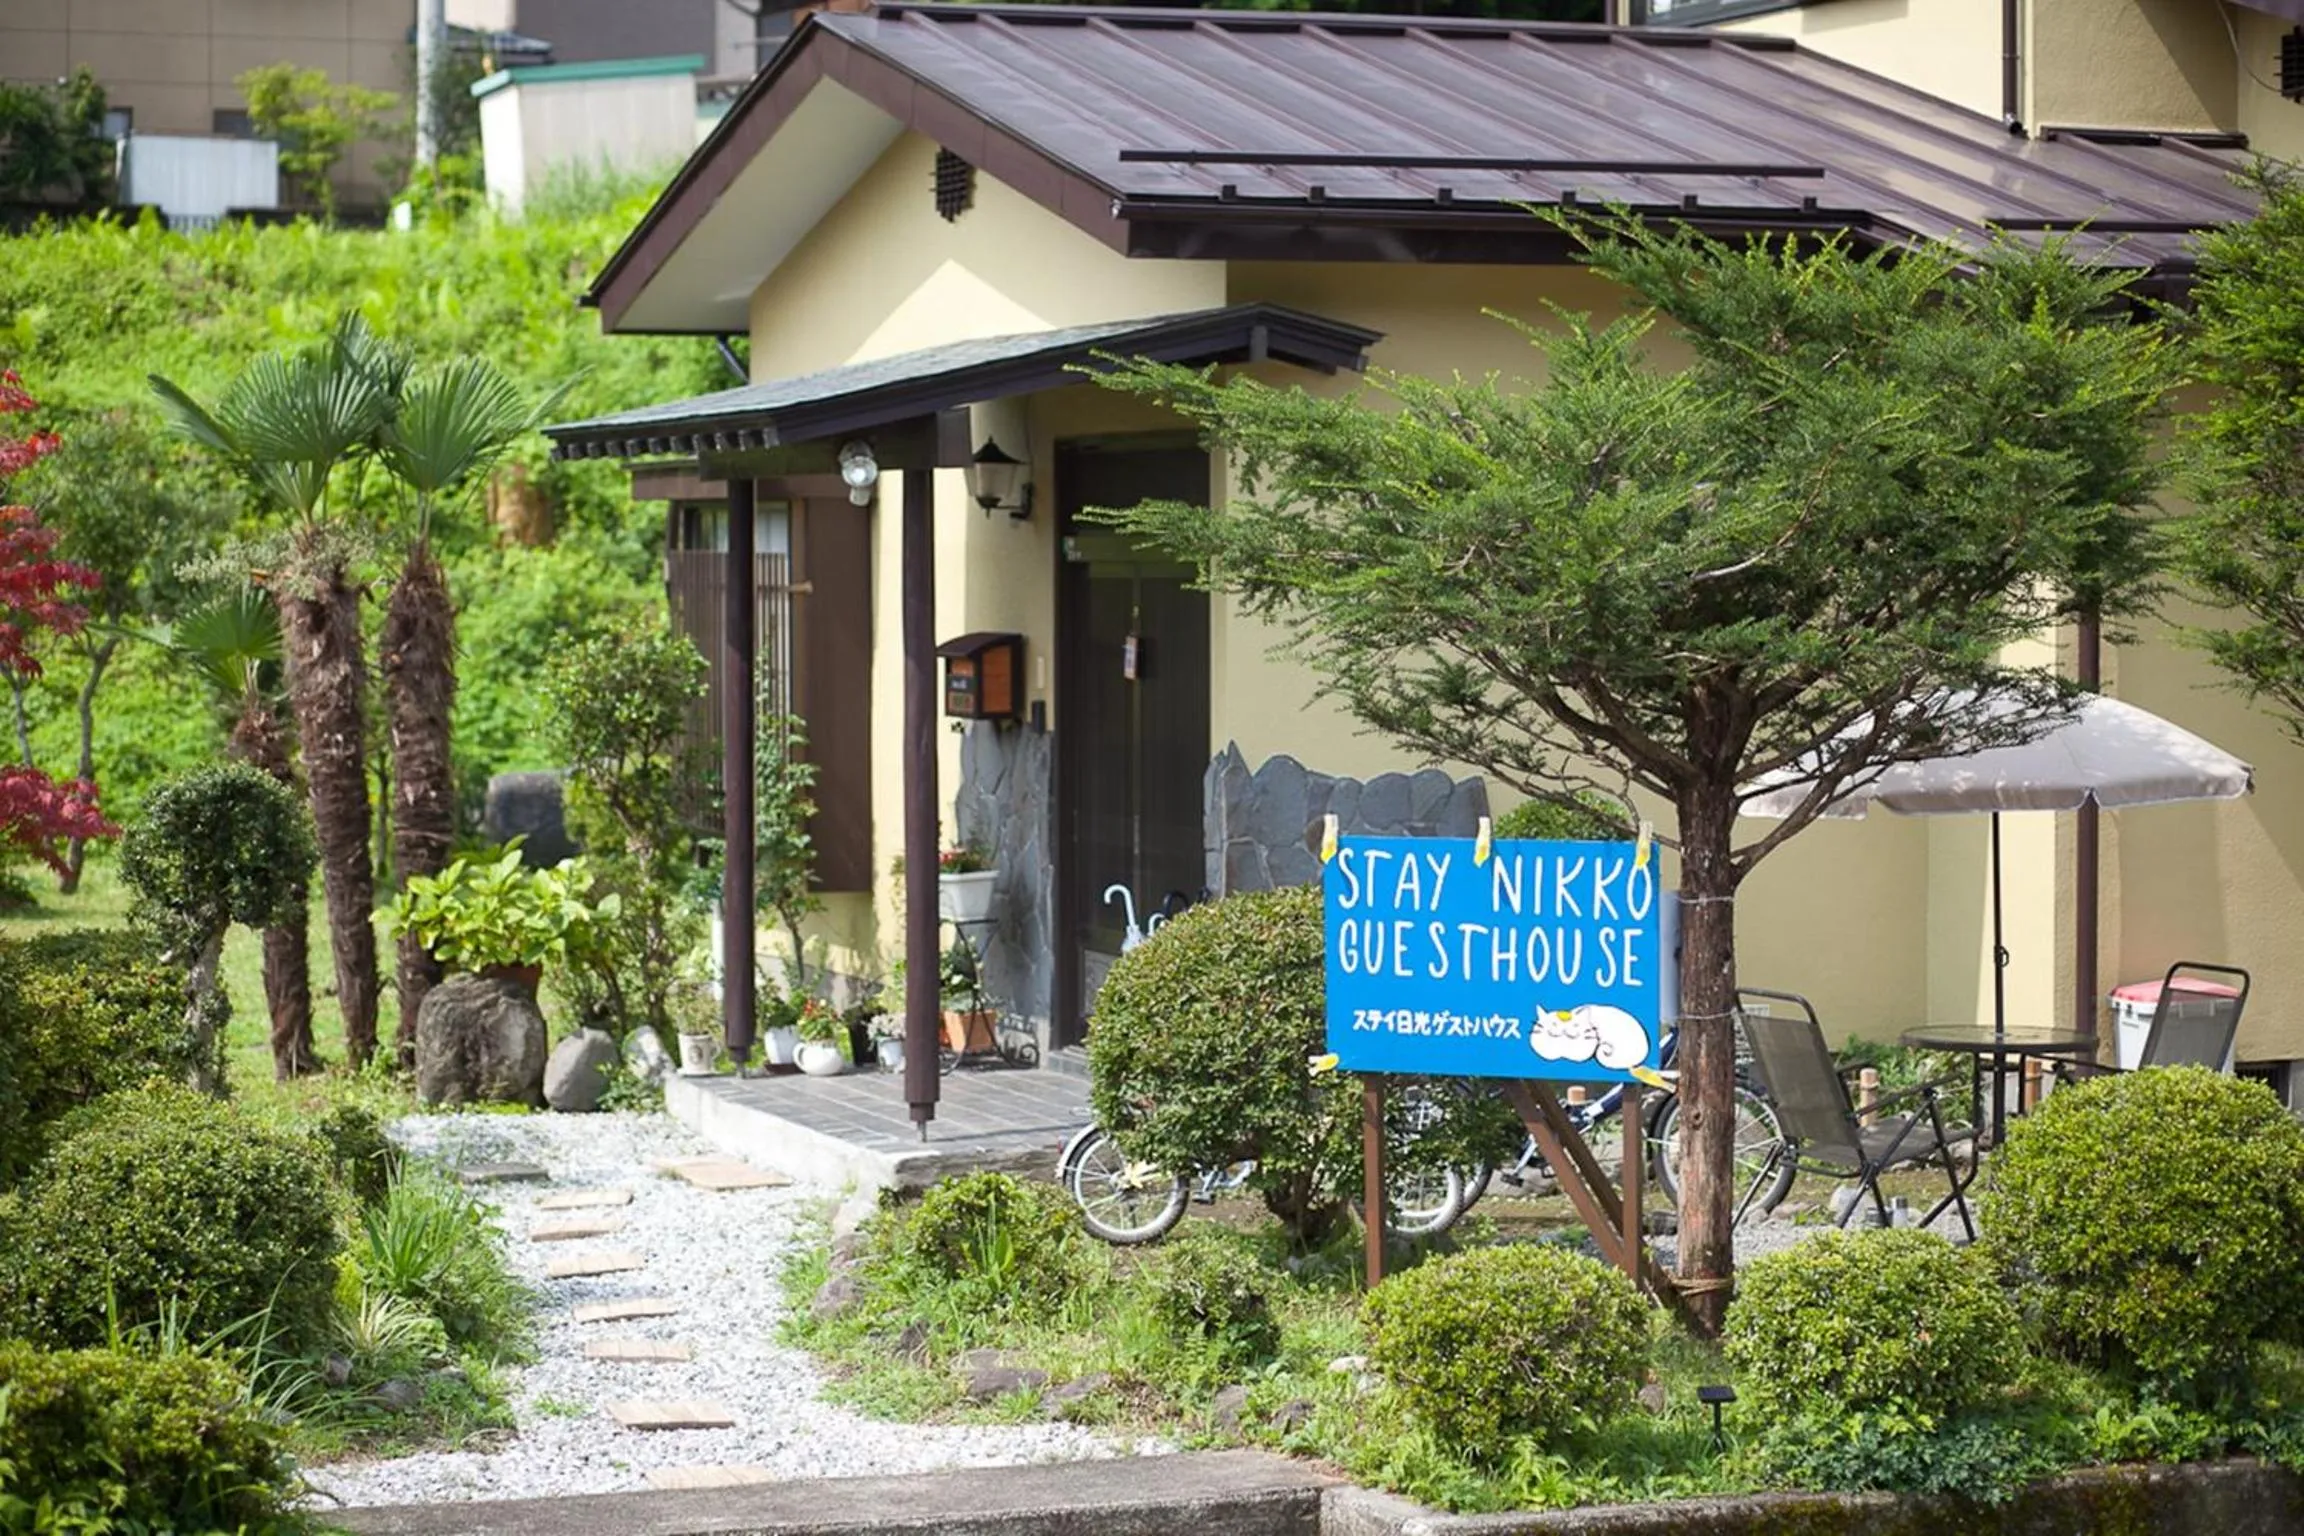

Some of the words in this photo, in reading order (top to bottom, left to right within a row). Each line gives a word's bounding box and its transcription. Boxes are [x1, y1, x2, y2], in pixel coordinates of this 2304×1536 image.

[1338, 848, 1451, 911] STAY
[1492, 855, 1651, 920] NIKKO
[1338, 918, 1644, 988] GUESTHOUSE
[1352, 1009, 1521, 1039] ステイ日光ゲストハウス
